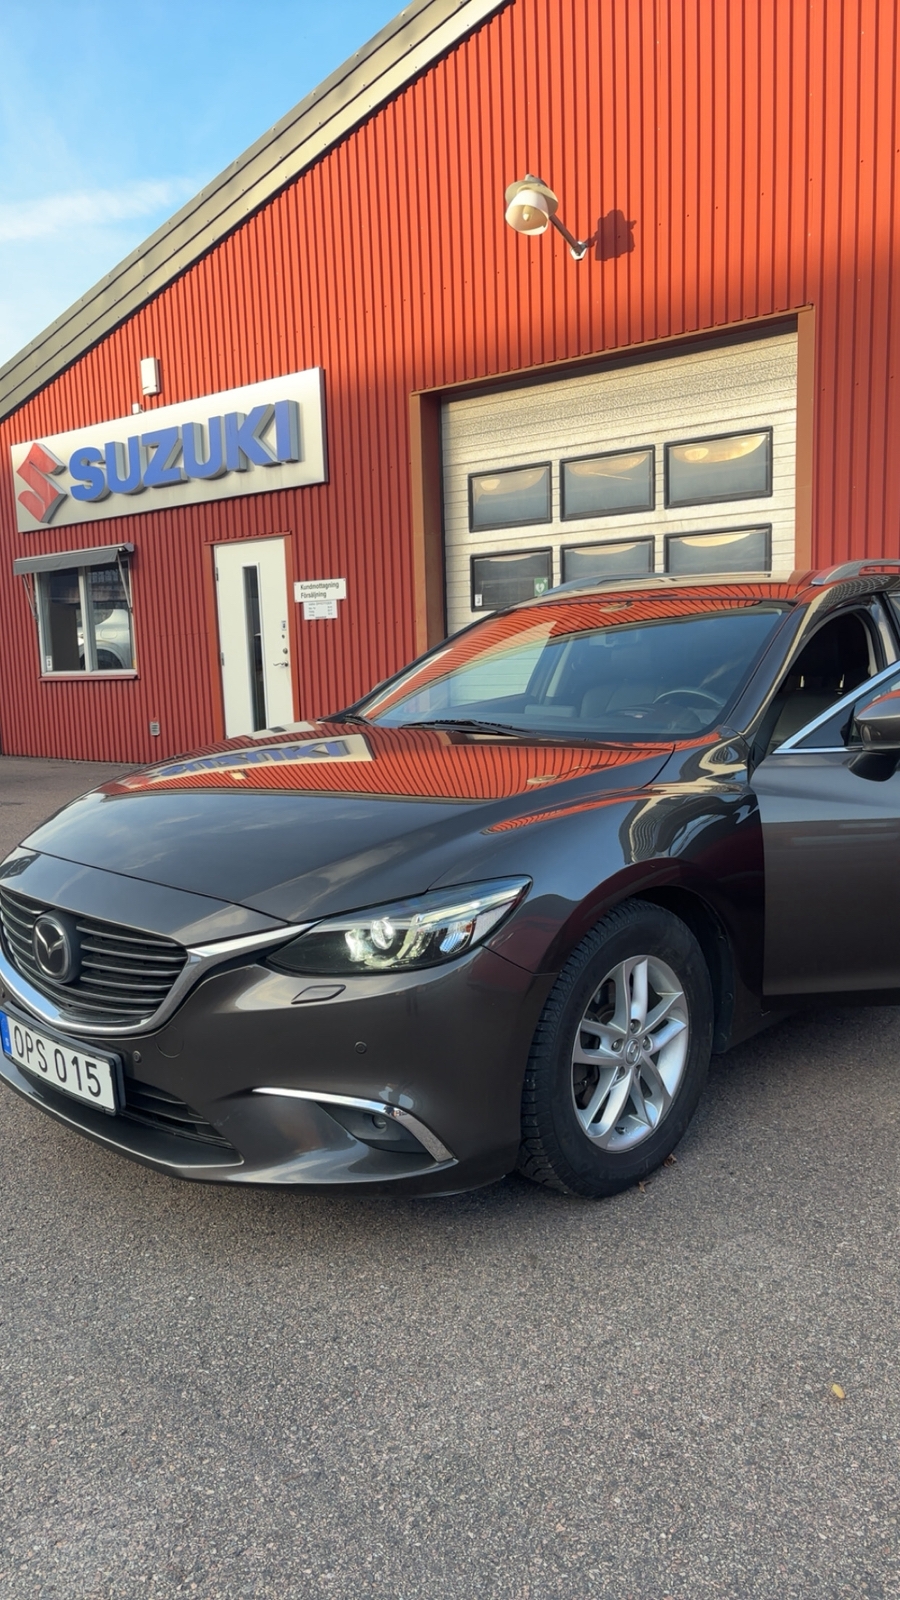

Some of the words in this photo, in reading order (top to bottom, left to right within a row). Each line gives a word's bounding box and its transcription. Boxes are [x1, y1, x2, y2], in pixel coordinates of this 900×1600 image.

[69, 399, 299, 502] SUZUKI
[300, 591, 327, 599] Försäljning
[14, 1025, 48, 1073] OPS
[54, 1048, 101, 1097] 015
